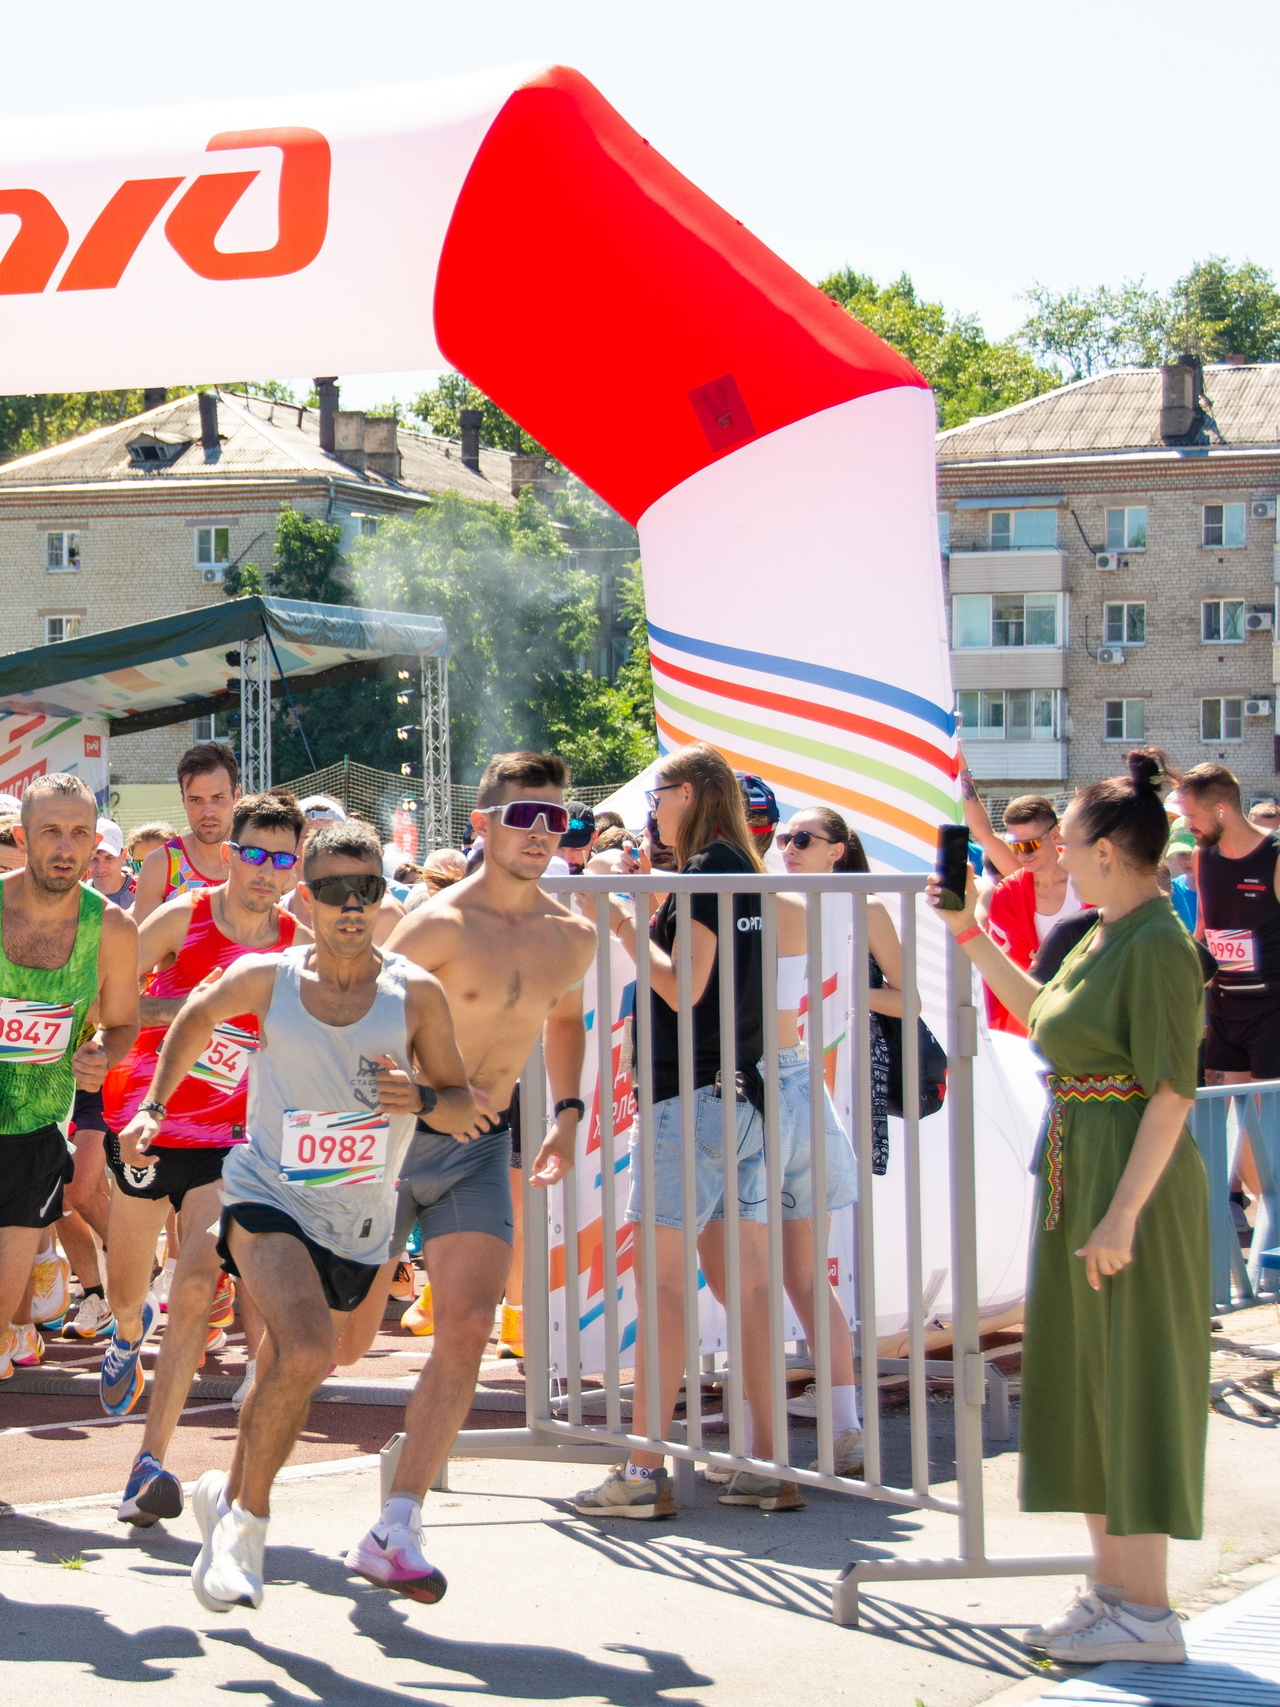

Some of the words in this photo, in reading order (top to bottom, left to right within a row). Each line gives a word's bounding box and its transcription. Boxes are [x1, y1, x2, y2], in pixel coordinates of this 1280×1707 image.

[1210, 941, 1245, 959] 0996
[204, 1037, 241, 1073] 54
[298, 1134, 376, 1164] 0982
